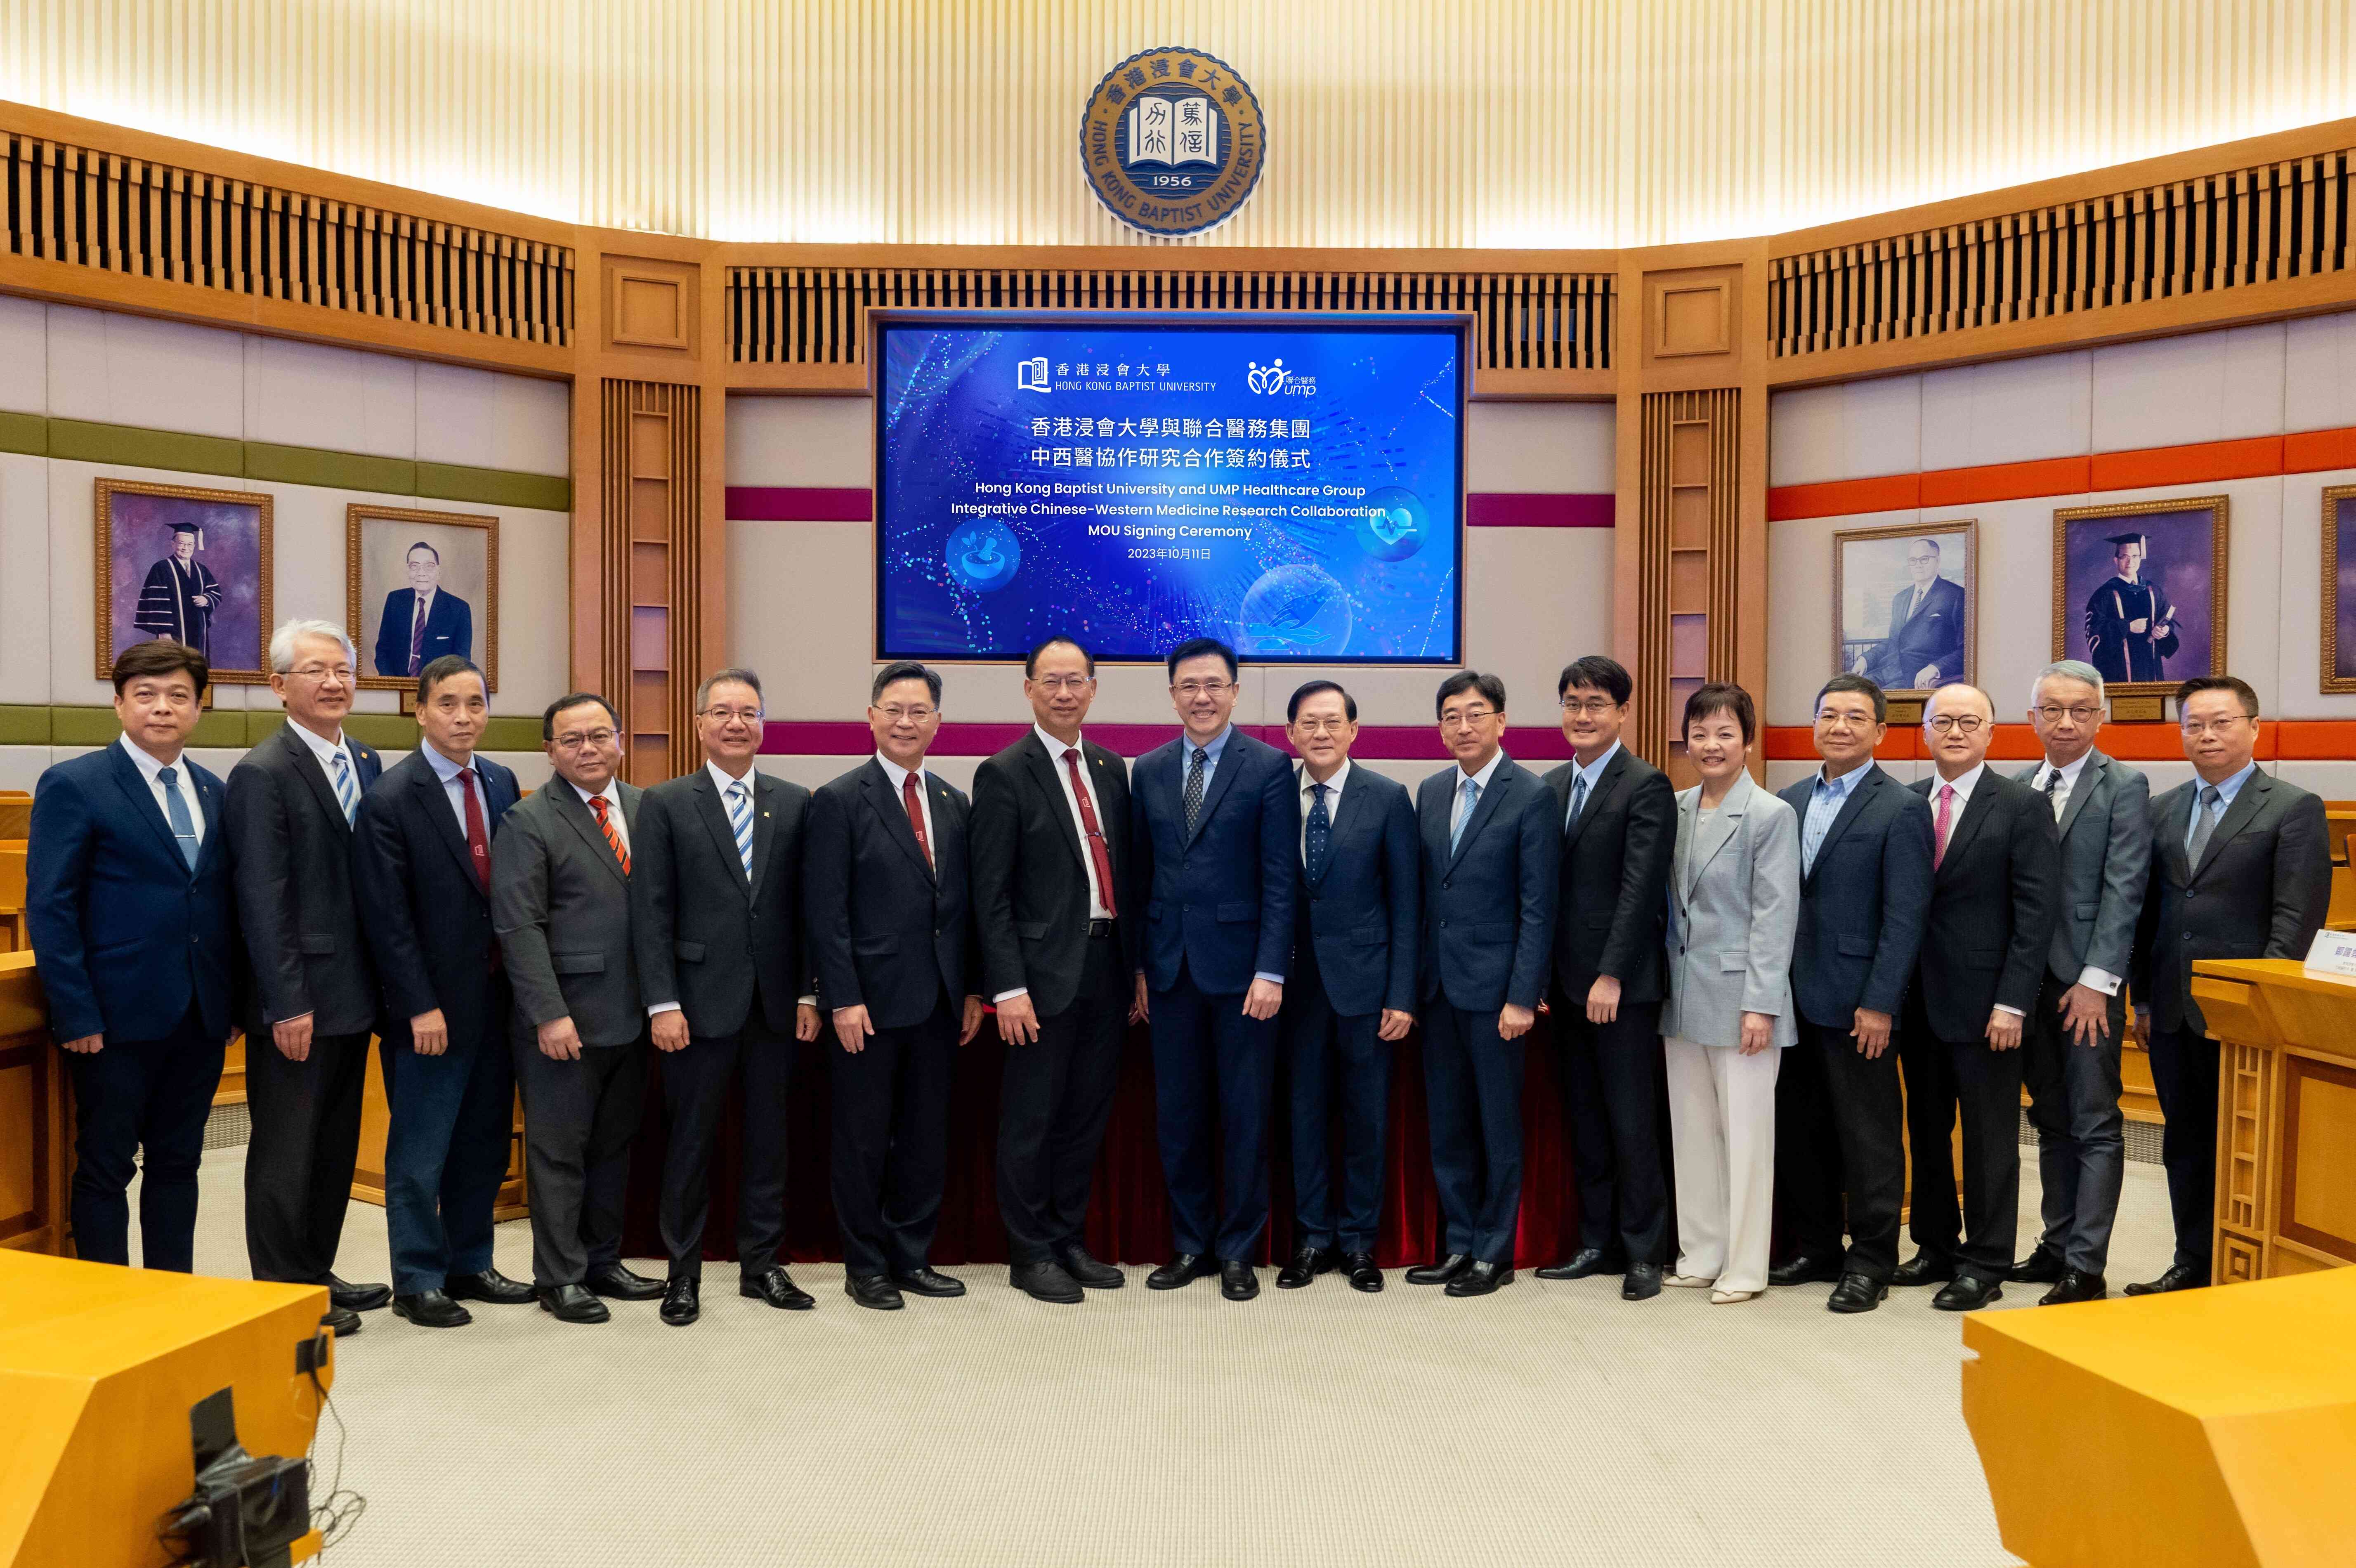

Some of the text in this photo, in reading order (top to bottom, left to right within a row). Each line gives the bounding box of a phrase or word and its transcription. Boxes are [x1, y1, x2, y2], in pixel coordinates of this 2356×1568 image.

[1106, 58, 1242, 107] 香港浸會大學
[1092, 120, 1254, 223] HONG KONG BAPTIST UNIVERSITY
[1153, 176, 1191, 186] 1956
[1055, 363, 1170, 376] 香港浸會大學
[1055, 381, 1216, 391] HONG KONG BAPTIST UNIVERSITY
[1286, 376, 1315, 384] 聯合醫務
[1284, 385, 1316, 398] ump
[1031, 417, 1310, 439] 香港浸會大學與聯合醫務集團
[1032, 446, 1310, 468] 中西醫協作研究合作簽約儀式
[975, 482, 1366, 499] Hong Kong Baptist University and UMP Healthcare Group
[951, 503, 1386, 517] Integrative Chinese-Western Medicine Research Collaboration
[1088, 525, 1252, 540] MOU Signing Ceremony
[1128, 548, 1210, 560] 2023年10月11日
